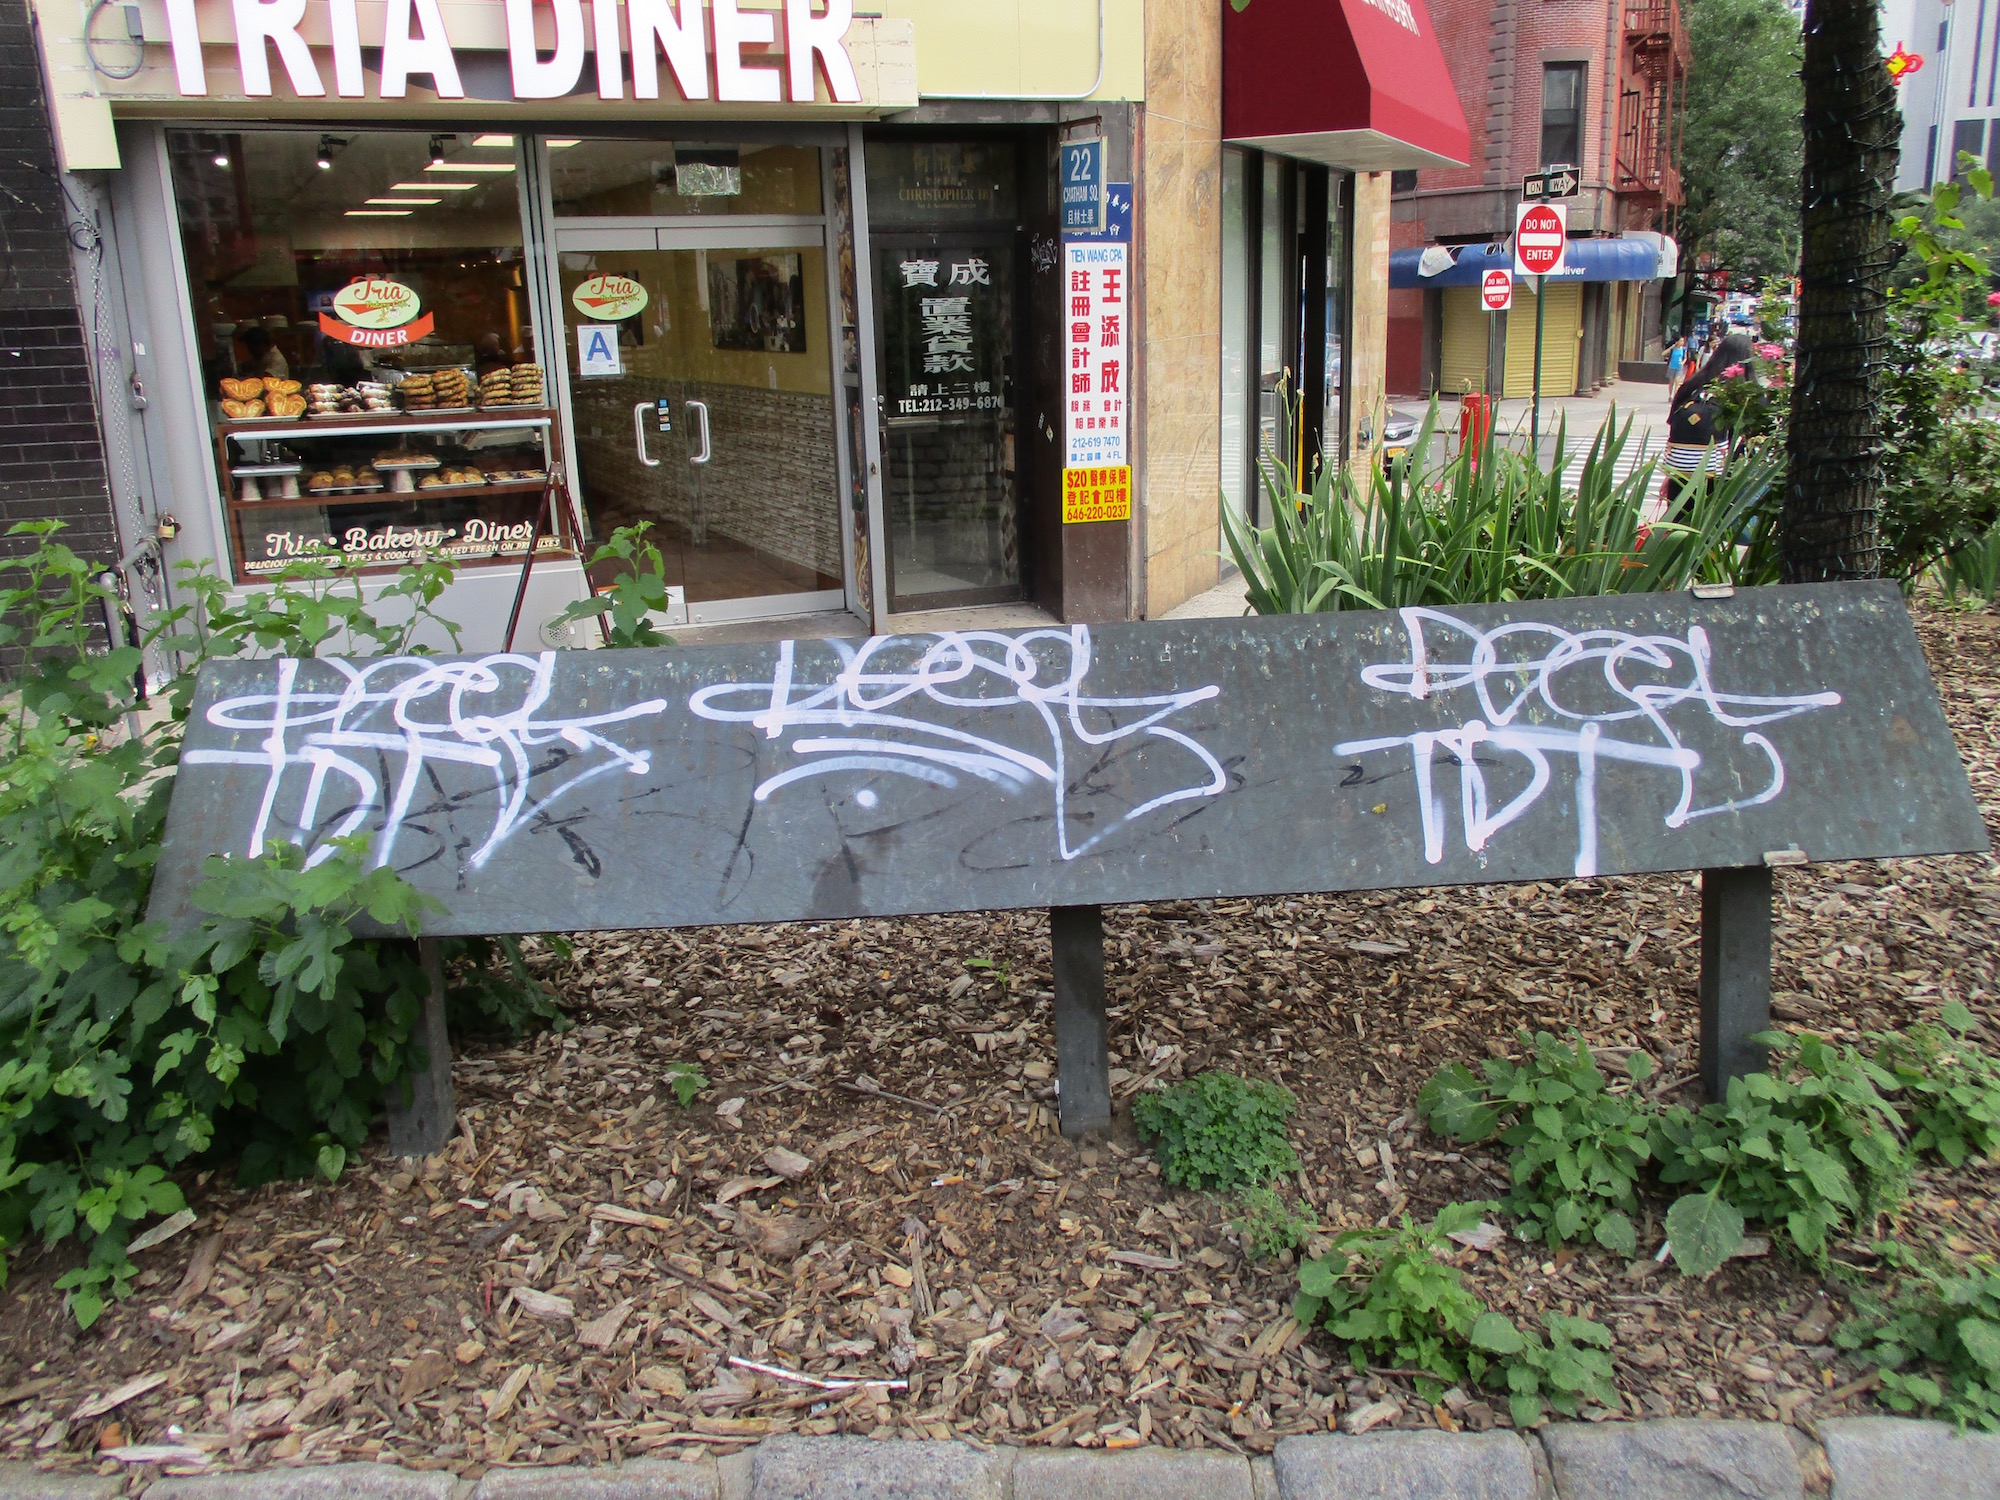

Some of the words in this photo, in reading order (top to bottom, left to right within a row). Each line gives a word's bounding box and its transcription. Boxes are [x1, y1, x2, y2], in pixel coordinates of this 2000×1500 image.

[505, 0, 863, 104] DINER
[1070, 148, 1092, 181] 22
[899, 188, 974, 201] CHRISTOPHER
[1063, 185, 1088, 204] CHATHAM
[1530, 180, 1543, 193] ON
[1553, 179, 1571, 191] WAY
[1525, 218, 1538, 230] DO
[1540, 218, 1557, 230] NOT
[1086, 249, 1108, 263] WANG
[1109, 248, 1123, 263] CPA
[1526, 249, 1554, 261] ENTER
[350, 274, 411, 301] Tria
[588, 272, 640, 297] Tria
[1487, 277, 1496, 286] DO
[1495, 277, 1507, 285] NOT
[1488, 294, 1505, 303] ENTER
[349, 329, 409, 347] DINER
[1071, 270, 1091, 394] 註冊會計師
[1101, 269, 1121, 393] 王添成
[586, 331, 613, 362] A
[1103, 436, 1121, 447] 7470
[1067, 470, 1087, 489] $20
[1067, 490, 1089, 506] 登記
[1104, 488, 1127, 504] 四樓
[1066, 504, 1127, 521] 646-220-0237
[342, 525, 444, 553] Bakery
[463, 519, 534, 543] Diner
[384, 549, 422, 560] COOKIES
[469, 543, 499, 553] FRESH
[501, 541, 514, 551] ON
